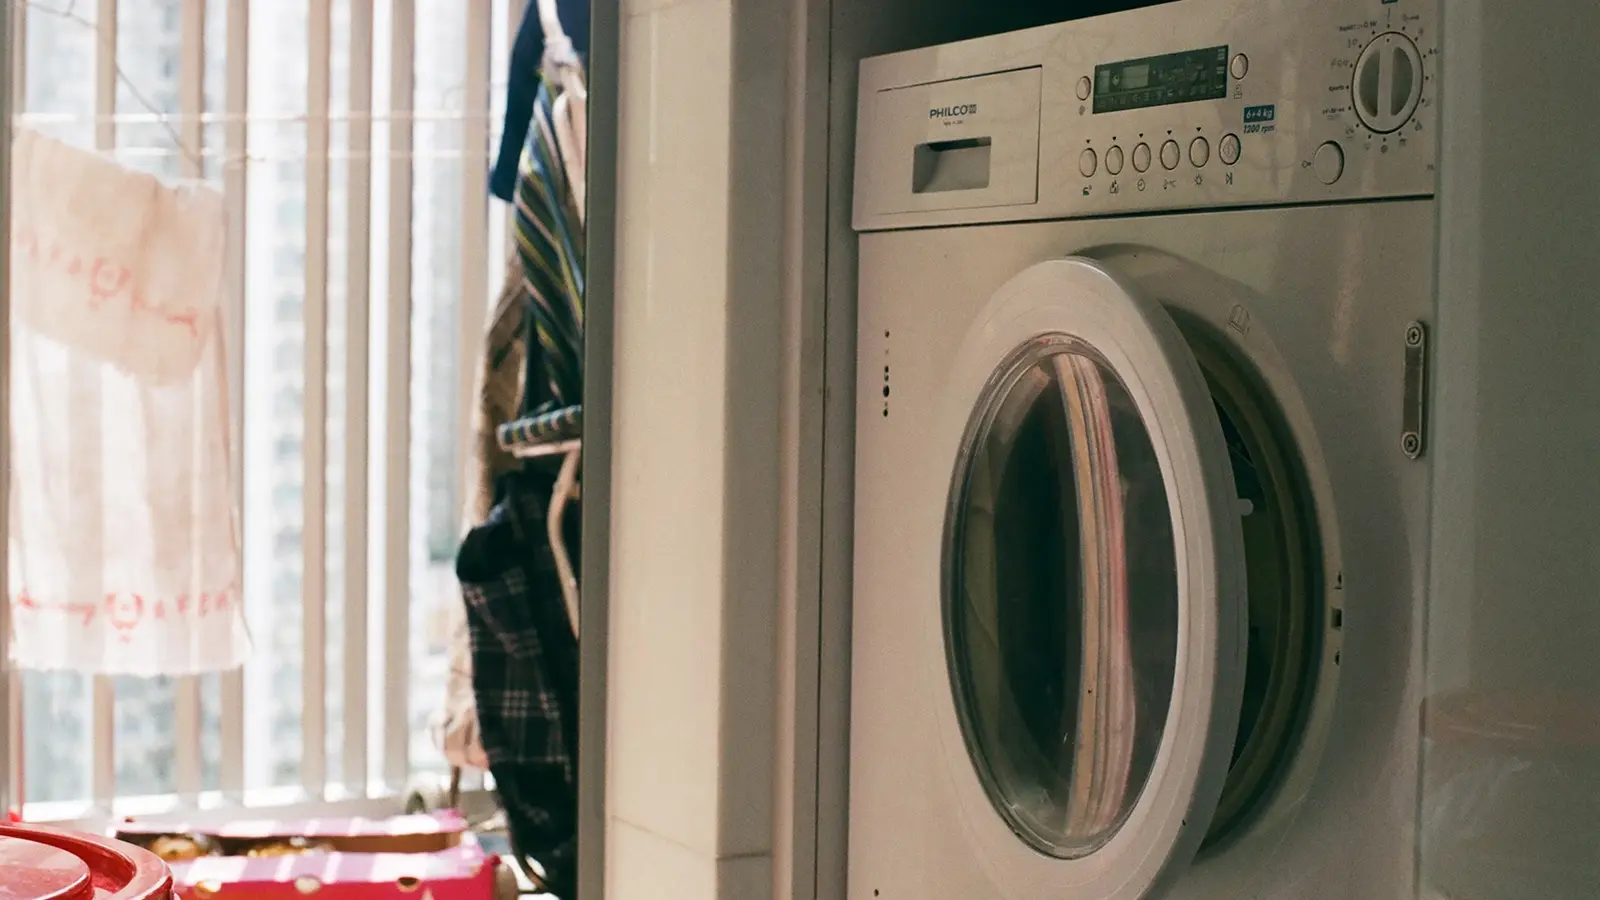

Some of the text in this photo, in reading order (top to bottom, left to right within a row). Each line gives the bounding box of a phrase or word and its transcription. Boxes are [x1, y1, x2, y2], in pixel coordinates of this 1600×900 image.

[930, 104, 968, 119] PHILCO
[1246, 108, 1272, 119] 6+4 kg
[1244, 124, 1275, 134] 1200 rpm
